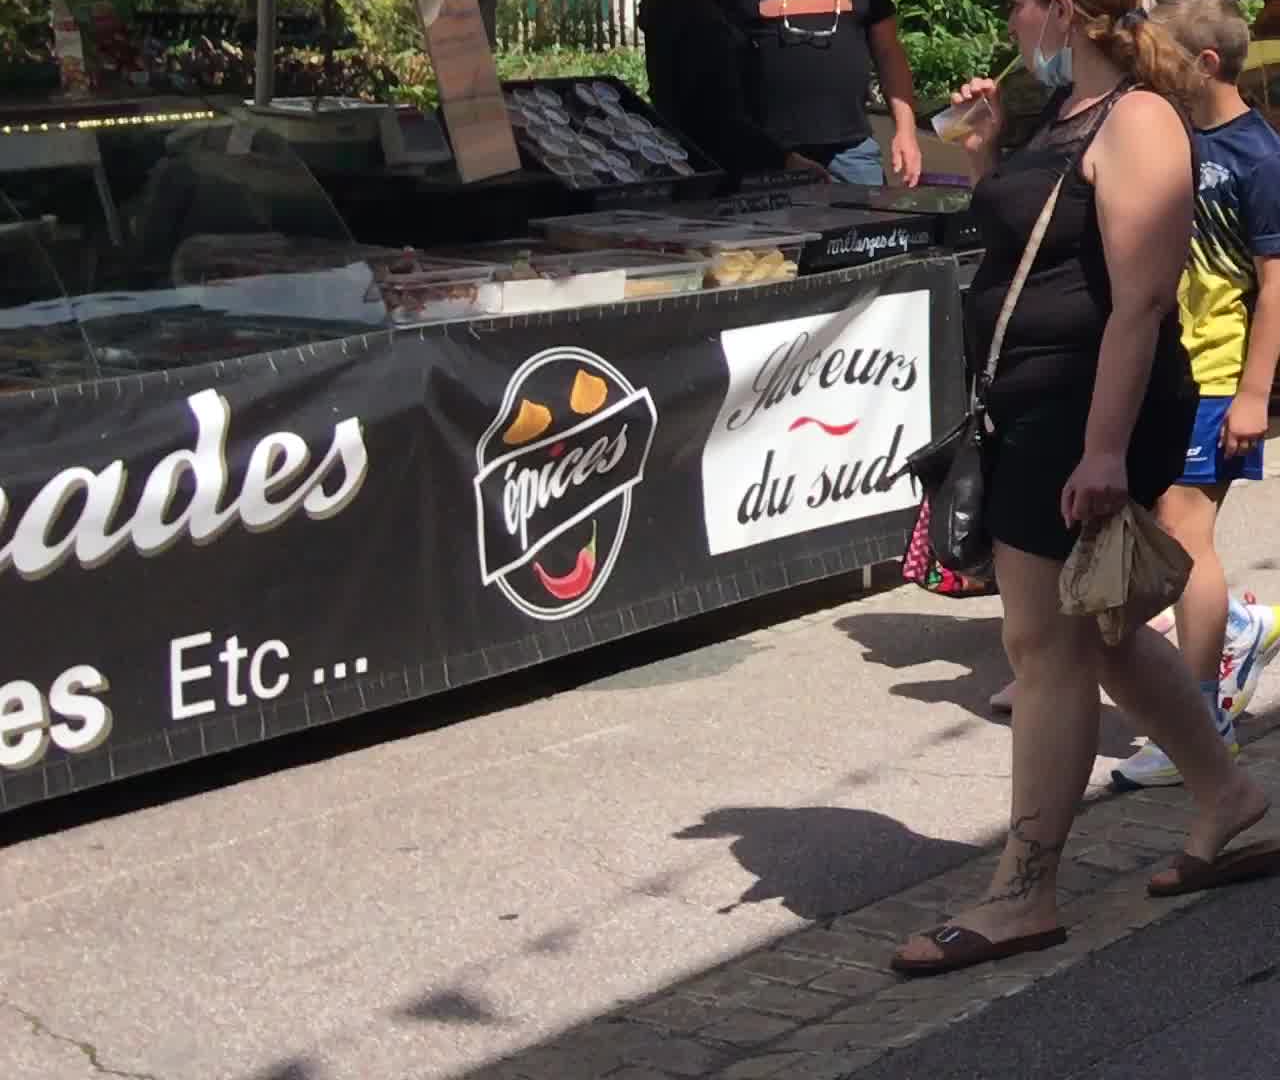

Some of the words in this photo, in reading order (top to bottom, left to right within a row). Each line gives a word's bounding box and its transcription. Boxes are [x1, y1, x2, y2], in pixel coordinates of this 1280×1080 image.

[726, 331, 919, 432] Saveurs
[0, 388, 369, 581] ades
[503, 423, 629, 552] épices
[737, 449, 798, 525] du
[806, 423, 904, 508] sud
